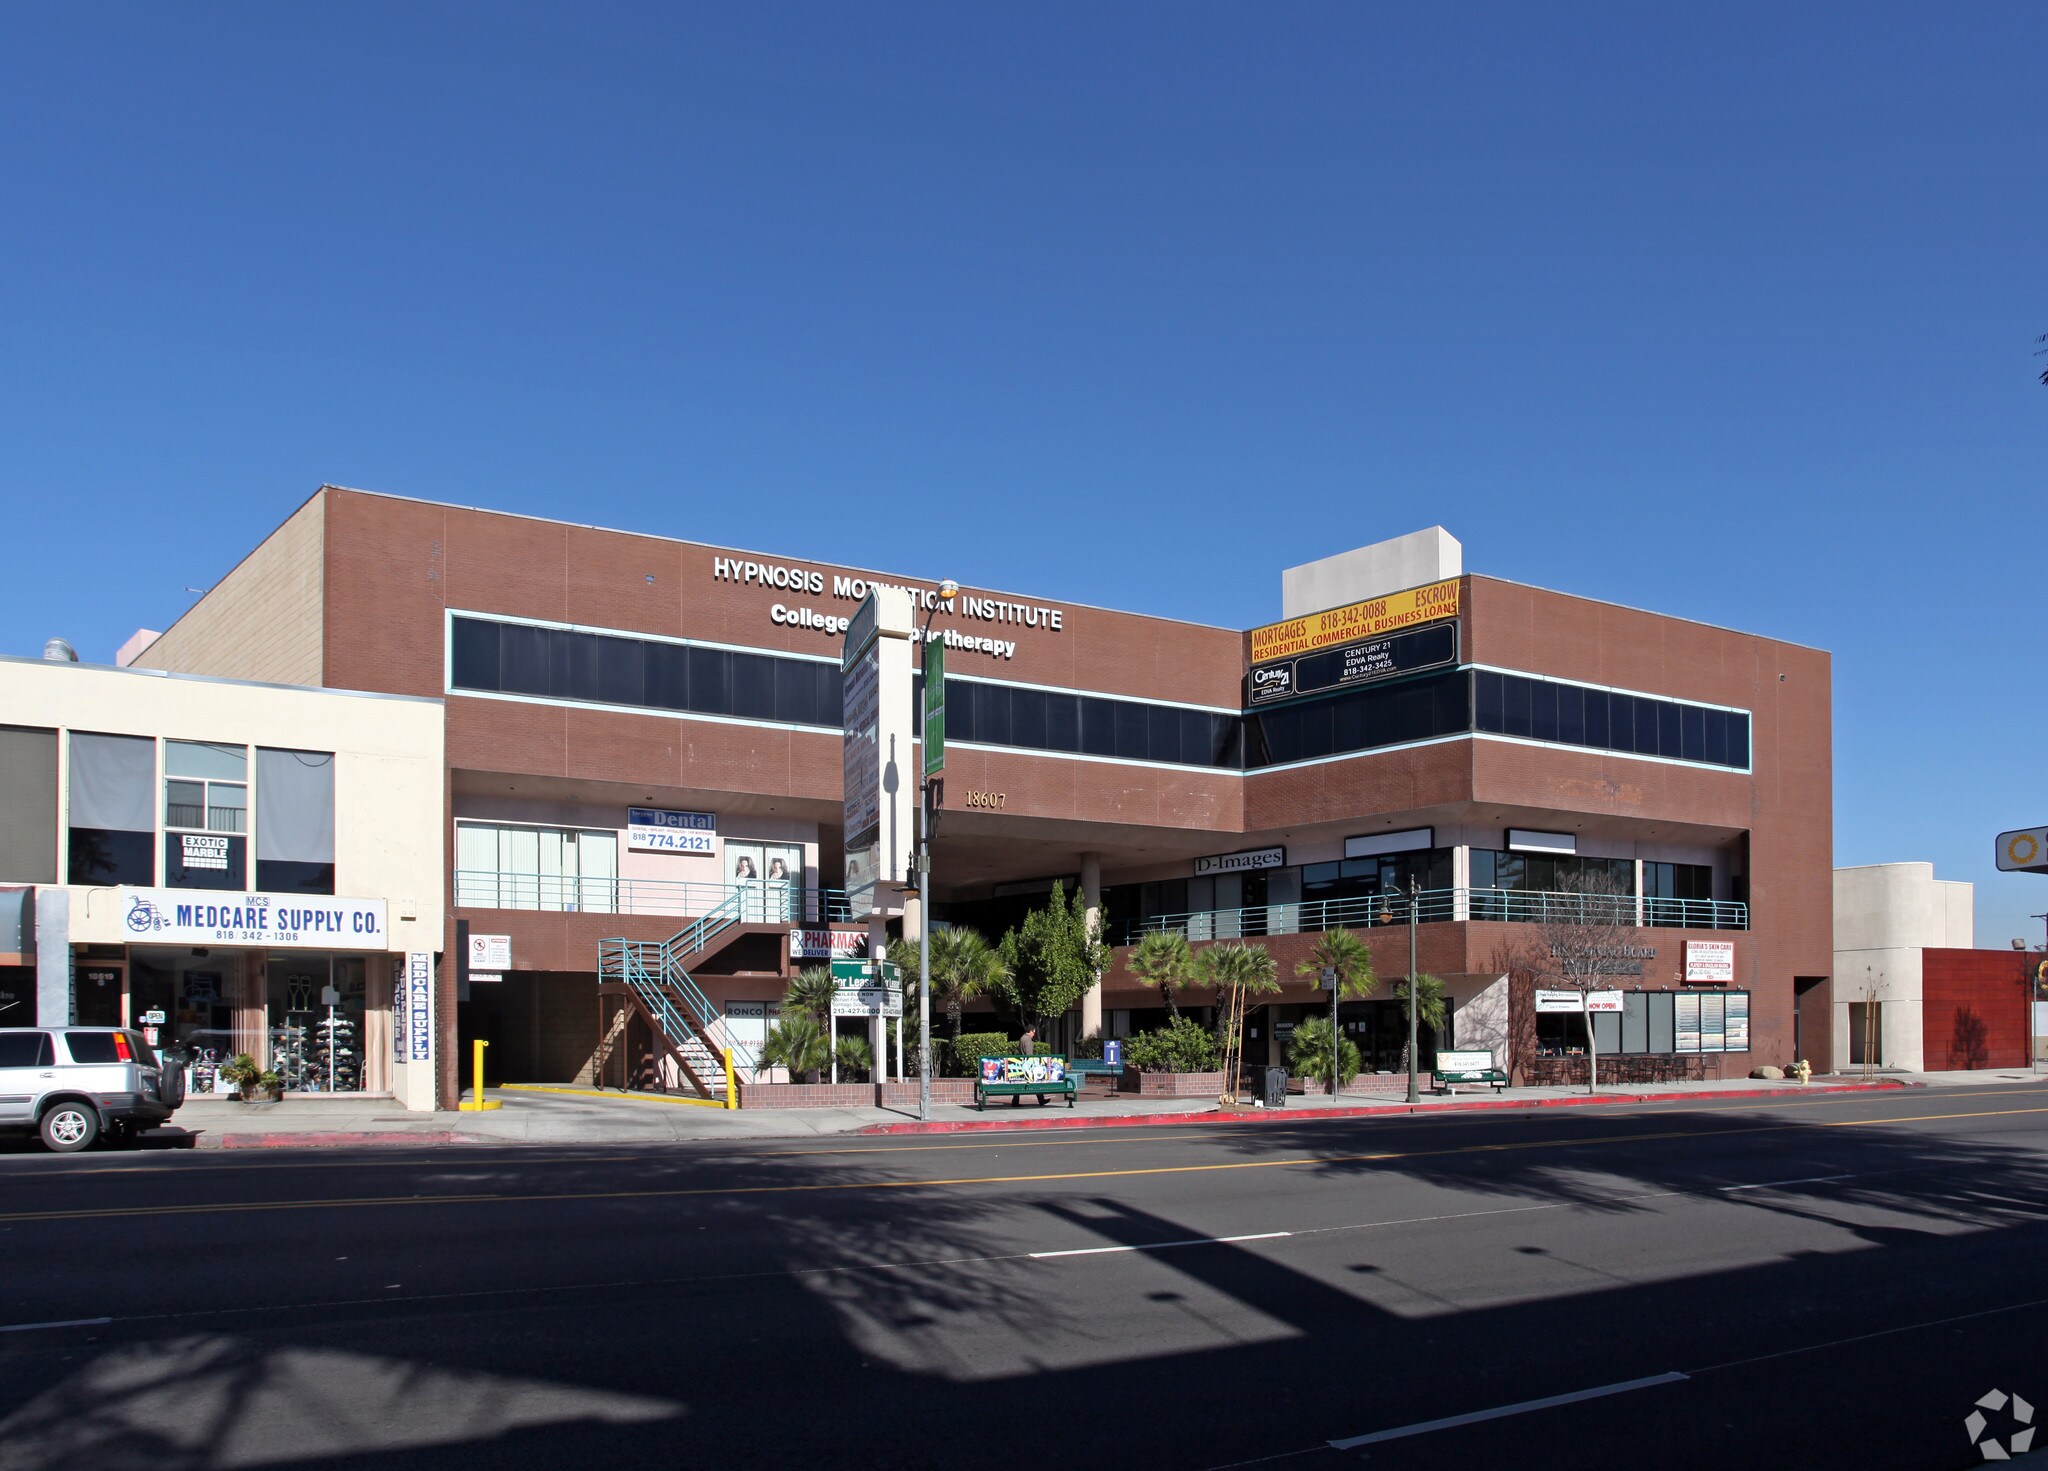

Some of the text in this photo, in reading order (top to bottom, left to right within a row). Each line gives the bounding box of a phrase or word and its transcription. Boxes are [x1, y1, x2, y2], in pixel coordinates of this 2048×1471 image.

[714, 557, 1063, 630] HYPNOSIS MOTION INSTITUTE
[771, 604, 850, 635] College
[1254, 582, 1457, 648] MORTGAGES 818-342-0088 ESCROW
[1254, 601, 1457, 660] RESIDENTIAL COMMERCIAL BUSINESS LOANS
[1345, 641, 1391, 658] CENTURY 21
[1343, 659, 1393, 676] 818-342-3425
[1346, 652, 1389, 667] EDVA Realty
[1255, 669, 1284, 683] Century
[1280, 671, 1290, 685] 21
[966, 790, 1006, 808] 18607
[654, 811, 713, 829] Dental
[185, 837, 225, 848] EXOTIC
[633, 833, 710, 850] 818 774.2121
[183, 847, 227, 859] MARBLE
[1197, 852, 1281, 872] D-Images
[247, 897, 269, 906] MCS
[177, 905, 381, 934] MEDCARE SUPPLY CO.
[804, 932, 868, 949] PHARMAC
[803, 948, 828, 956] DELIVER
[832, 976, 875, 987] For Lease
[411, 953, 428, 1060] MEDCARE SUPPLY
[728, 1008, 762, 1016] RONCO
[148, 1012, 164, 1020] OPEN
